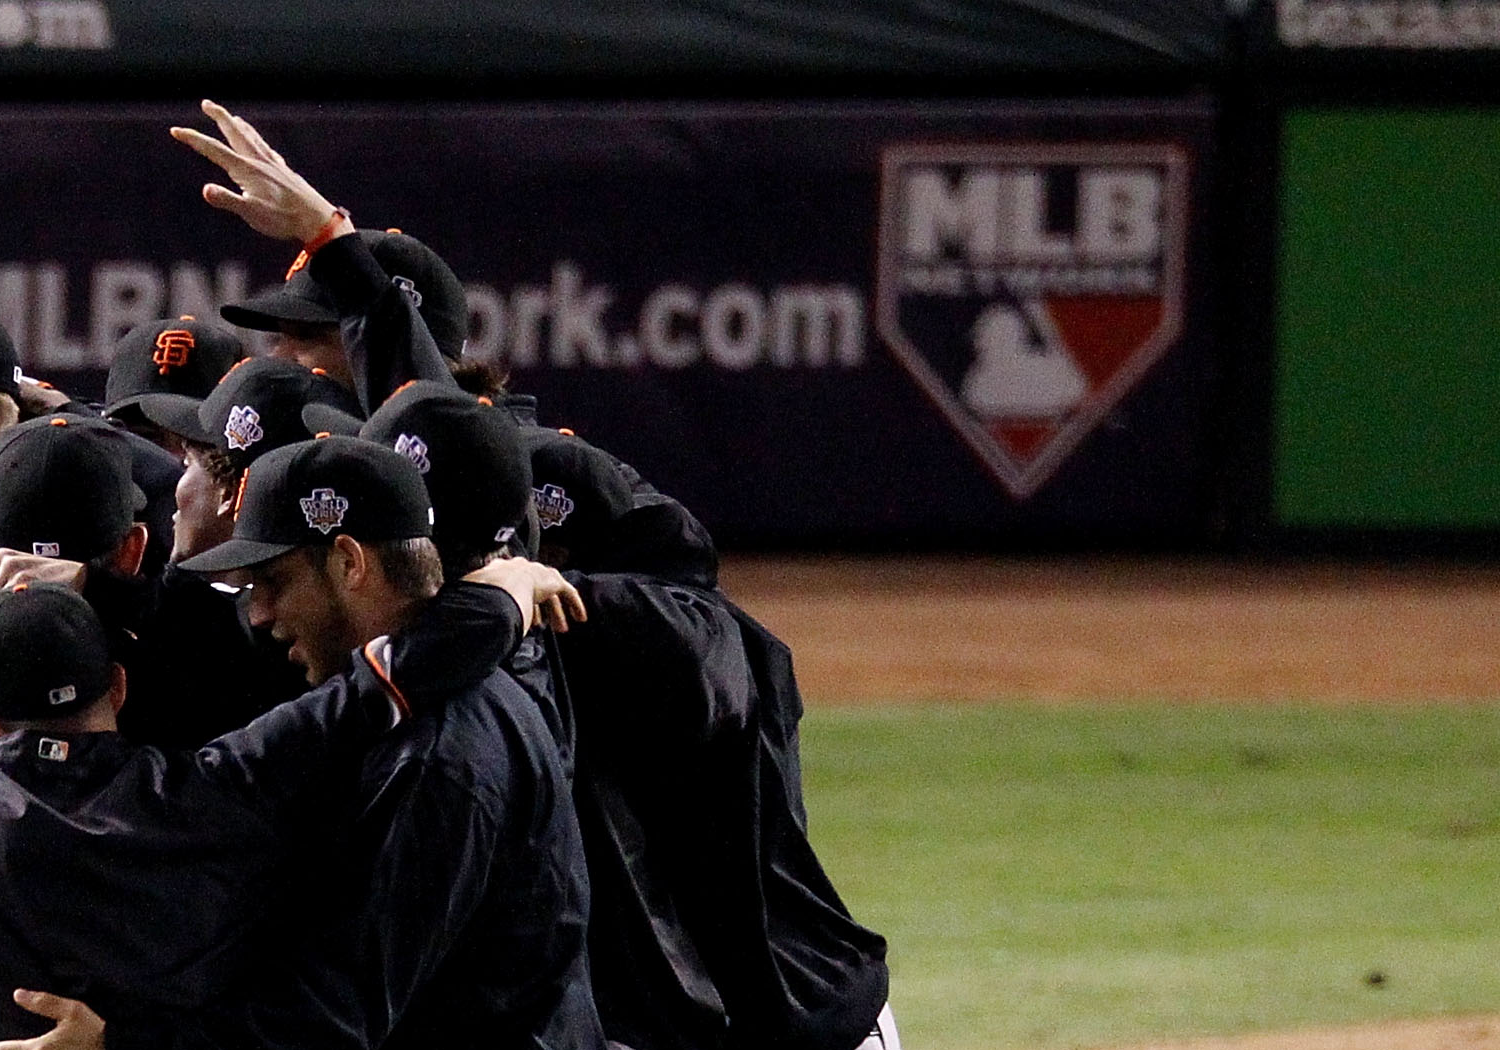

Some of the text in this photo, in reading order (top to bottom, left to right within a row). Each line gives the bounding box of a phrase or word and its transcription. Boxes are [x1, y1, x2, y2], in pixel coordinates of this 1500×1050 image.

[1277, 0, 1500, 49] texas
[904, 168, 1160, 264] MLB
[153, 328, 195, 376] SF
[301, 498, 347, 512] WORLD
